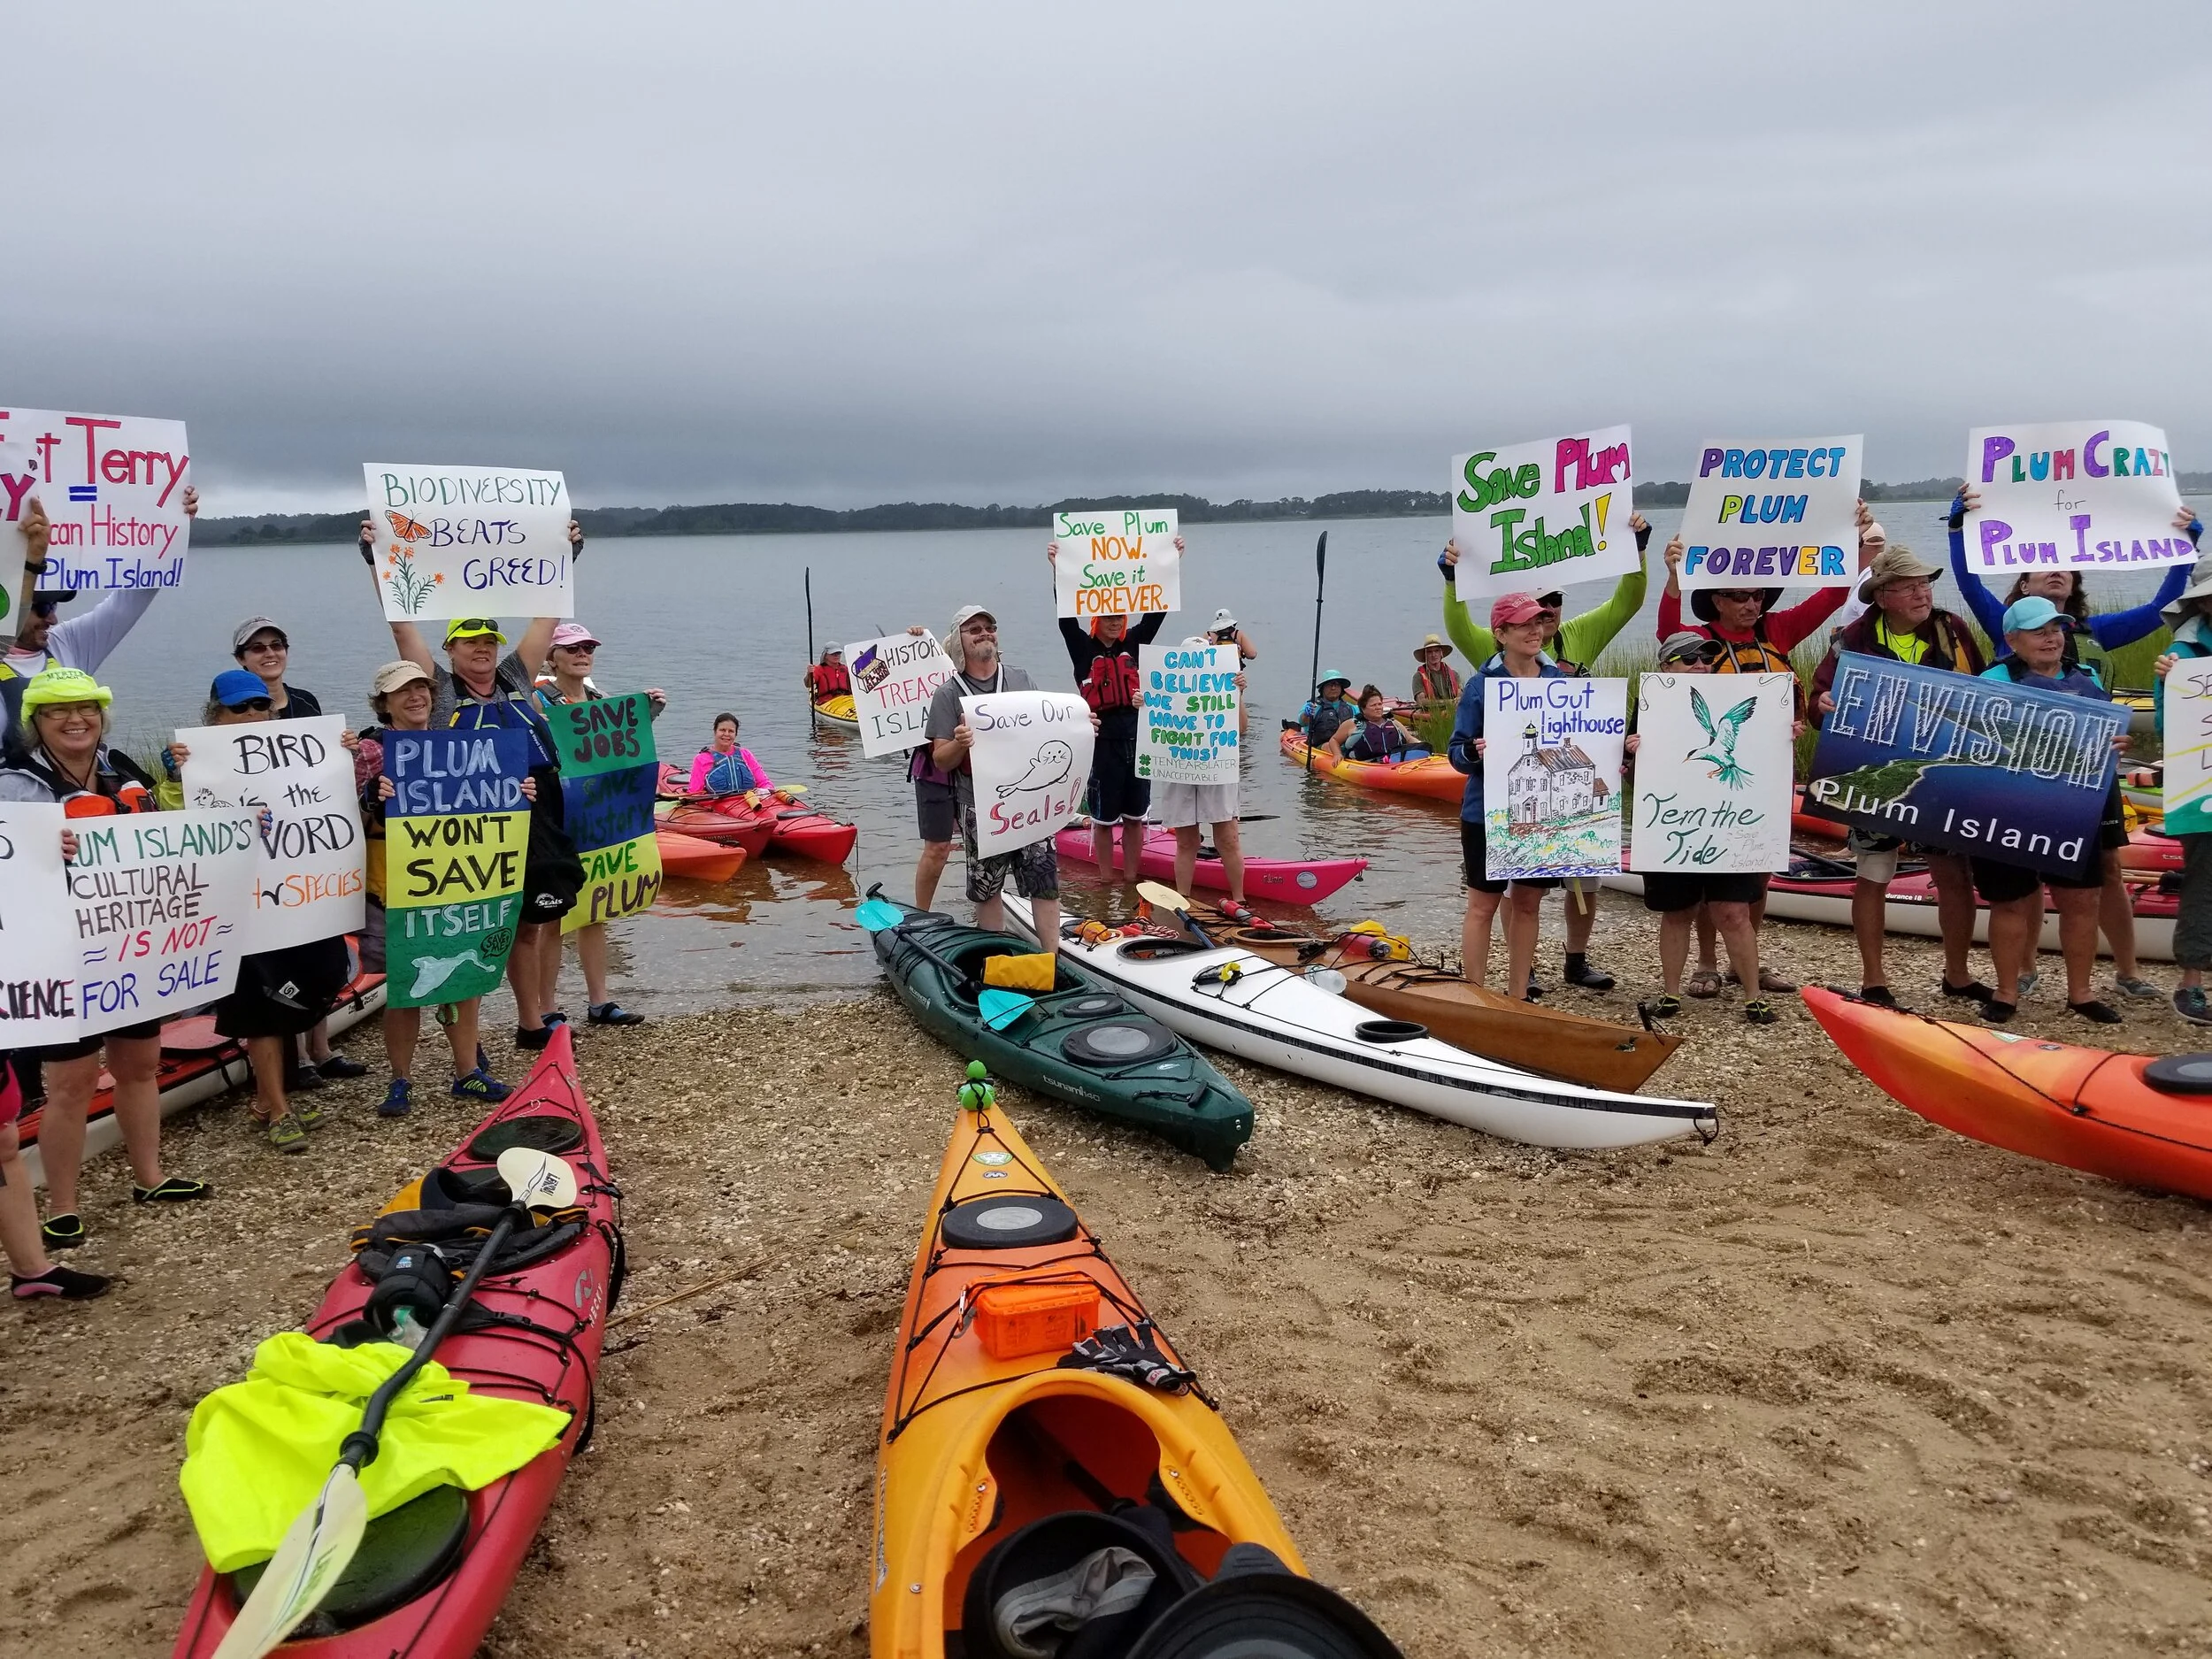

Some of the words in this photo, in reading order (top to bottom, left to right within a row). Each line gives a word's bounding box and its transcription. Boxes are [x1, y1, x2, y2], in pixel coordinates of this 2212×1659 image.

[65, 417, 189, 508] Terry
[1457, 451, 1540, 512] Save
[1555, 438, 1631, 494] Plum
[1700, 447, 1846, 479] PROTECT
[1982, 436, 2075, 483] PLUM
[380, 472, 560, 507] BIODIVERSITY
[2054, 488, 2086, 511] for
[1056, 511, 1105, 539] Save
[1125, 511, 1168, 535] Plum
[1718, 495, 1809, 524] PLUM
[91, 503, 178, 559] History
[428, 518, 526, 548] BEATS
[1092, 536, 1148, 561] NOW.
[1490, 492, 1611, 575] Island!
[1979, 519, 2059, 565] PLUM
[2070, 514, 2193, 563] ISLAND
[41, 557, 99, 590] Plum
[104, 557, 184, 589] Island!
[464, 555, 565, 590] GREED!
[1079, 564, 1125, 588] Save
[1133, 565, 1145, 583] it
[1686, 546, 1846, 576] FOREVER
[1076, 584, 1169, 615] FOREVER.
[1164, 649, 1217, 669] CAN'T
[1151, 671, 1236, 694] BELIEVE
[1498, 680, 1542, 711] Plum
[1546, 680, 1594, 710] Gut
[570, 697, 639, 735] SAVE
[975, 703, 1033, 732] Save
[1041, 699, 1074, 722] Our
[1144, 692, 1172, 710] WE
[1186, 694, 1235, 712] STILL
[1149, 710, 1197, 731] HAVE
[1203, 714, 1225, 729] TO
[1151, 728, 1204, 746] FIGHT
[1210, 730, 1237, 747] FOR
[1541, 710, 1626, 745] Lighthouse
[1827, 664, 2123, 792] ENVISION
[233, 733, 326, 774] BIRD
[396, 738, 502, 778] PLUM
[572, 727, 640, 764] JOBS
[1169, 746, 1218, 761] THIS!
[283, 783, 331, 808] the
[397, 776, 524, 814] ISLAND
[989, 777, 1082, 836] Seals!
[1643, 793, 1704, 828] Tern
[1710, 800, 1766, 828] the
[403, 814, 511, 849] WON'T
[1816, 779, 1918, 825] Plum
[1944, 808, 2085, 862] Island
[134, 818, 253, 860] ISLAND'S
[1663, 828, 1730, 864] Tide
[73, 863, 210, 900] CULTURAL
[282, 868, 362, 907] SPECIES
[407, 850, 518, 897] SAVE
[590, 870, 661, 923] PLUM
[75, 892, 203, 939] HERITAGE
[404, 898, 513, 939] ITSELF
[118, 930, 151, 962] IS
[160, 915, 218, 955] NOT
[83, 972, 140, 1019] FOR
[157, 950, 222, 997] SALE
